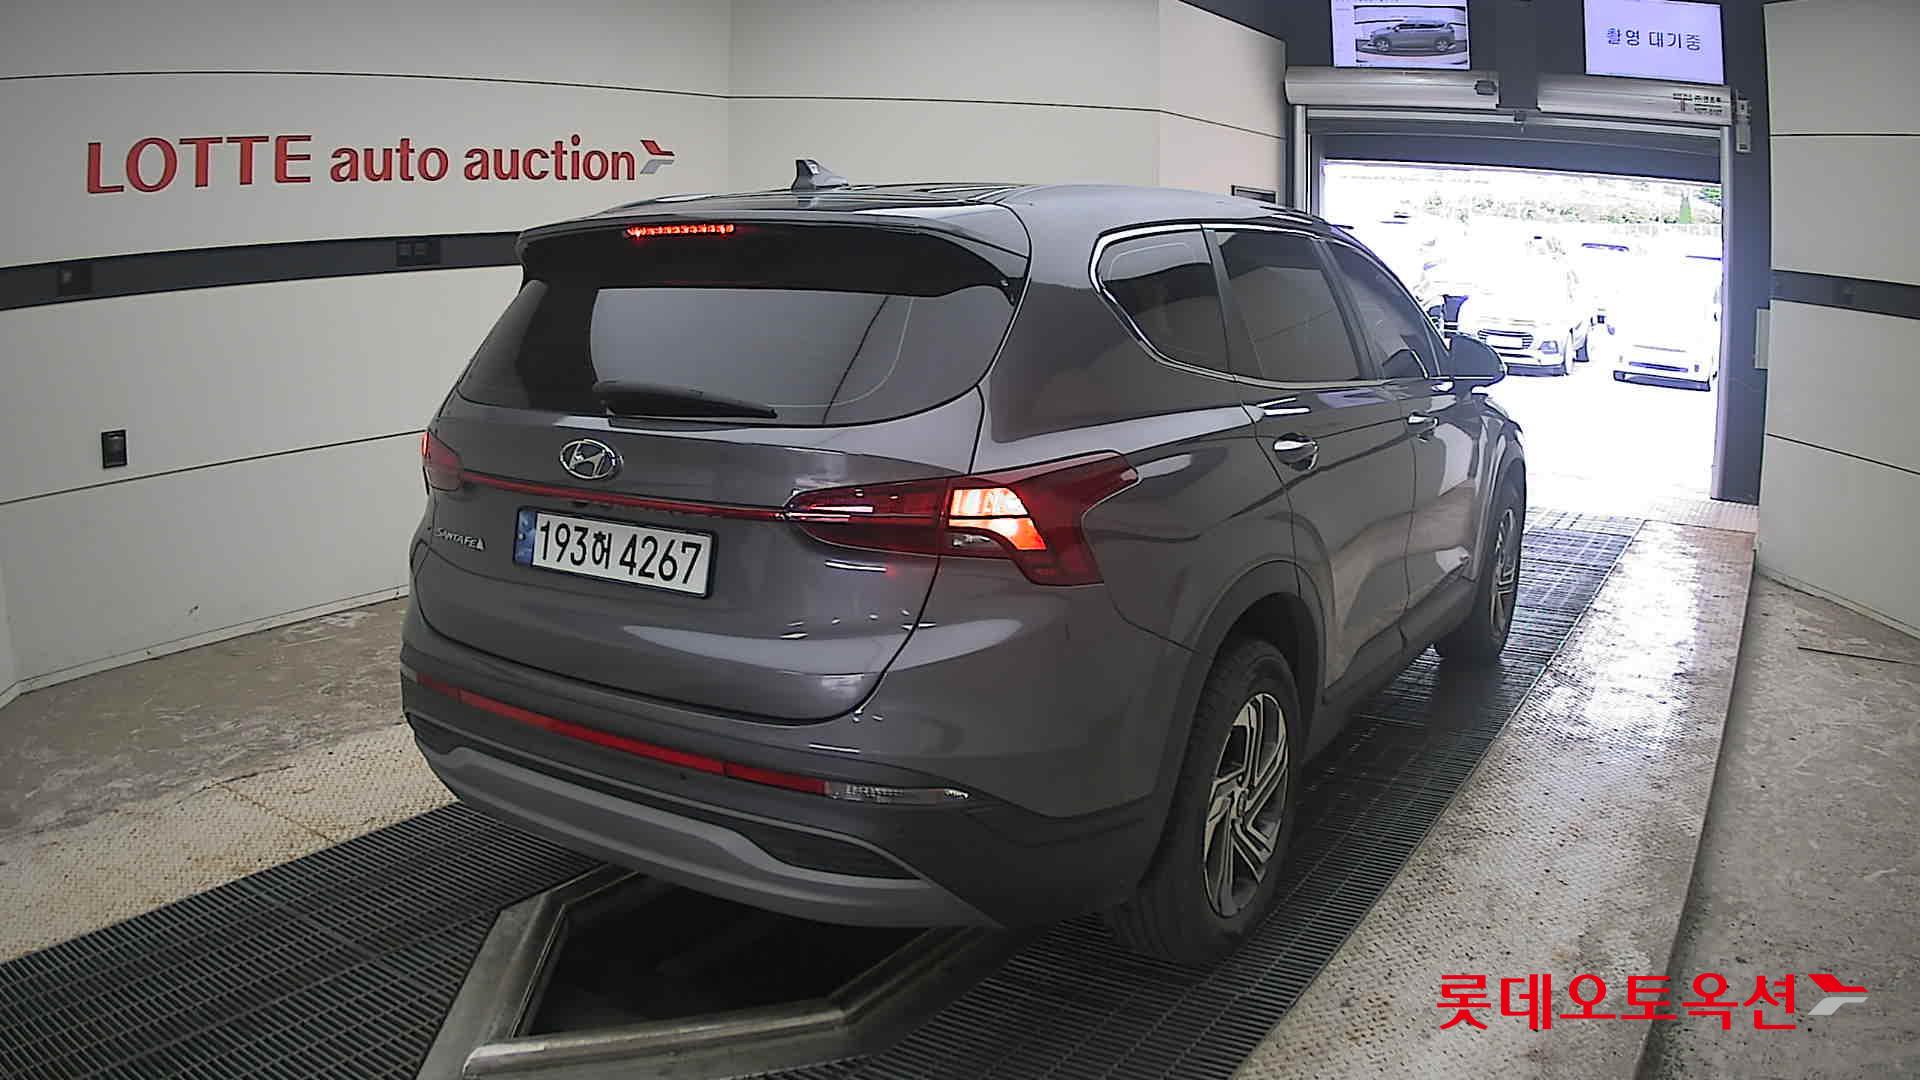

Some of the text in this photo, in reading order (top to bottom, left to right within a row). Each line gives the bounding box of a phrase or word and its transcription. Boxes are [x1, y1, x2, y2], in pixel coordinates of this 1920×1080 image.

[1649, 31, 1701, 51] 대기중
[87, 134, 636, 194] LOTTE auto auction
